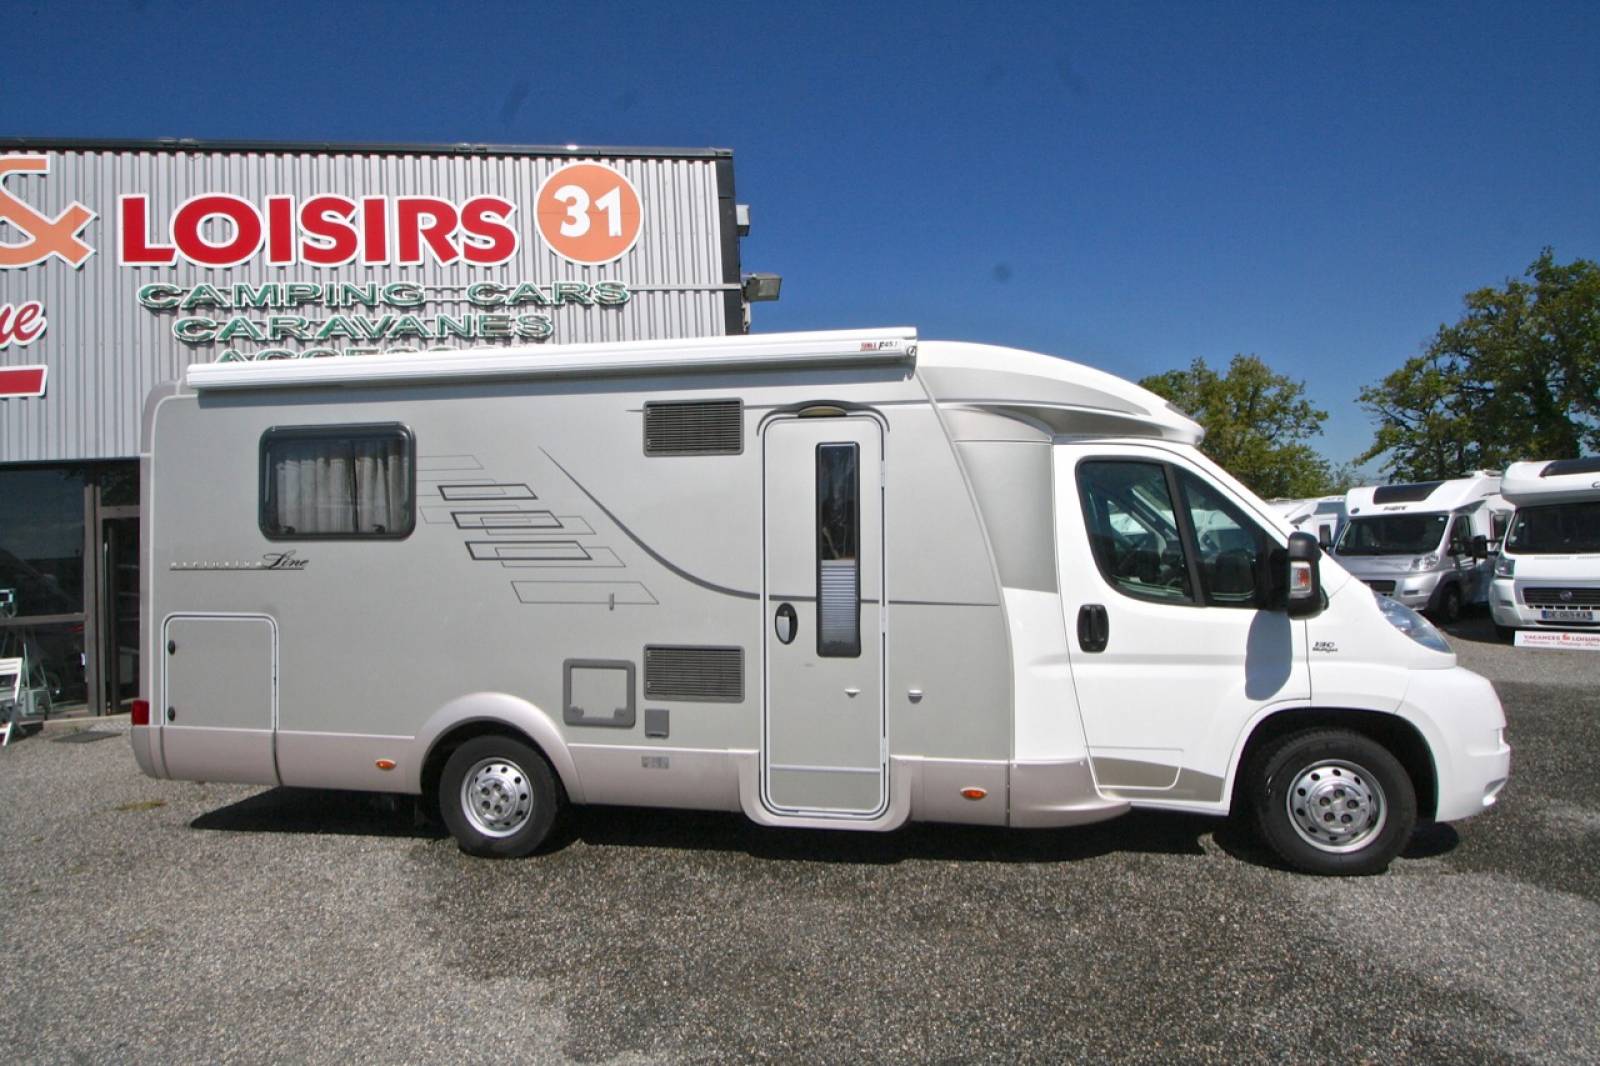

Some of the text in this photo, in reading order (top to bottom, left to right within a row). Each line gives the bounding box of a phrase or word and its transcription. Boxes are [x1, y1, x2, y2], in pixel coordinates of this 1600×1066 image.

[118, 191, 520, 267] LOISIRS
[553, 184, 622, 239] 31
[137, 279, 631, 309] CAMPING CARS
[171, 313, 554, 342] CARAVANES
[262, 549, 310, 570] Line
